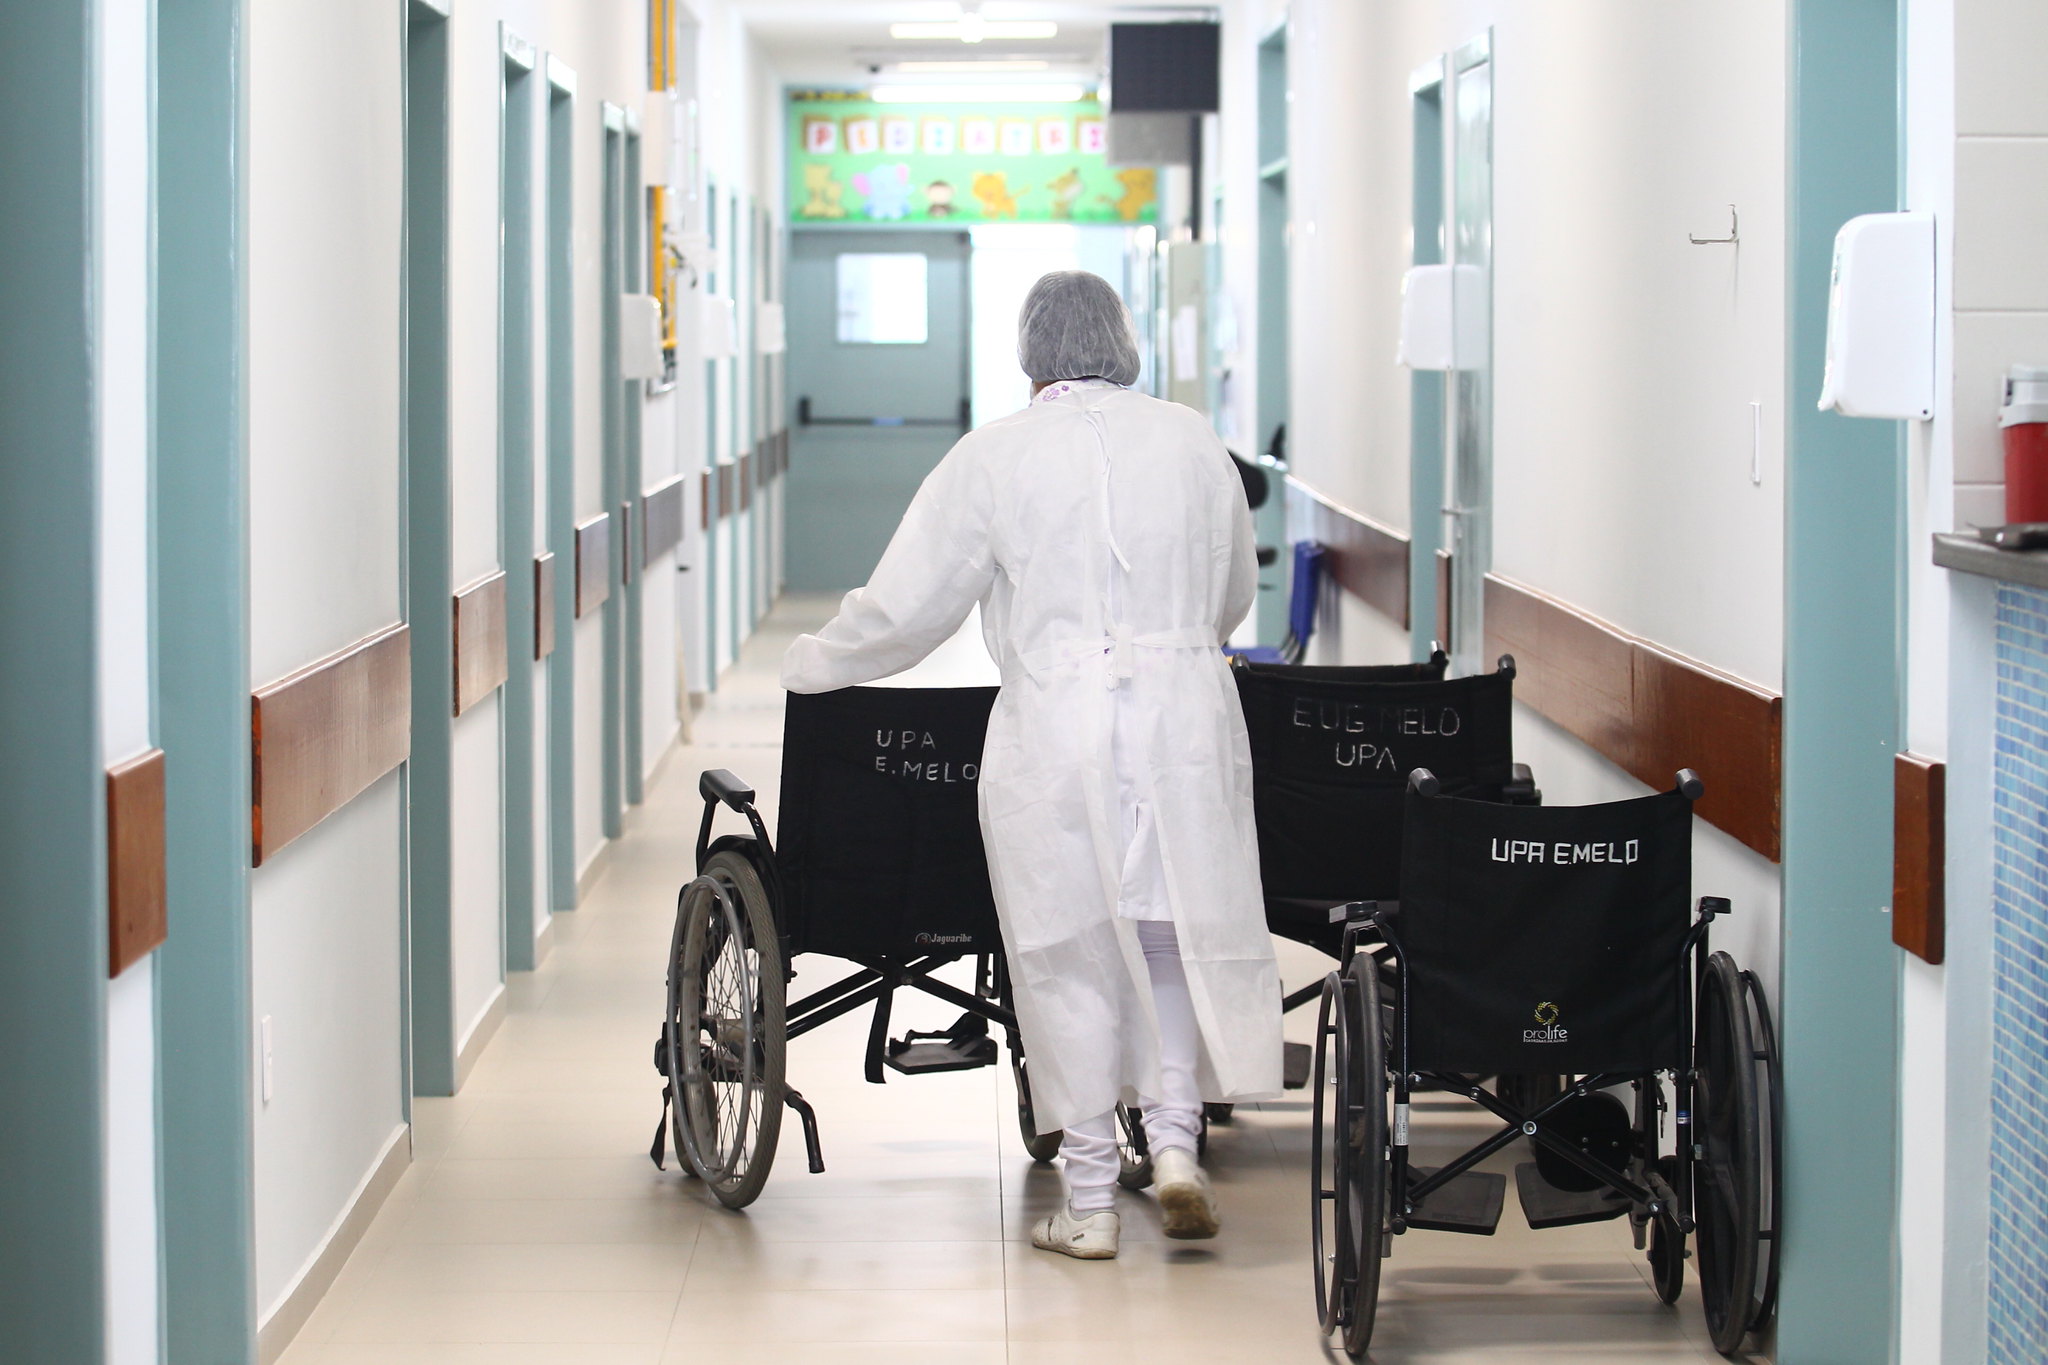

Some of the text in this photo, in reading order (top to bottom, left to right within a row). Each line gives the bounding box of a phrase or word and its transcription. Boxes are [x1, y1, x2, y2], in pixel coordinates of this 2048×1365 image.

[1380, 704, 1460, 736] MELO
[876, 729, 936, 750] UPA
[1336, 742, 1397, 771] UPA
[1491, 837, 1545, 864] UPA
[931, 933, 973, 945] Jaguaribe
[1523, 1024, 1568, 1042] prolife
